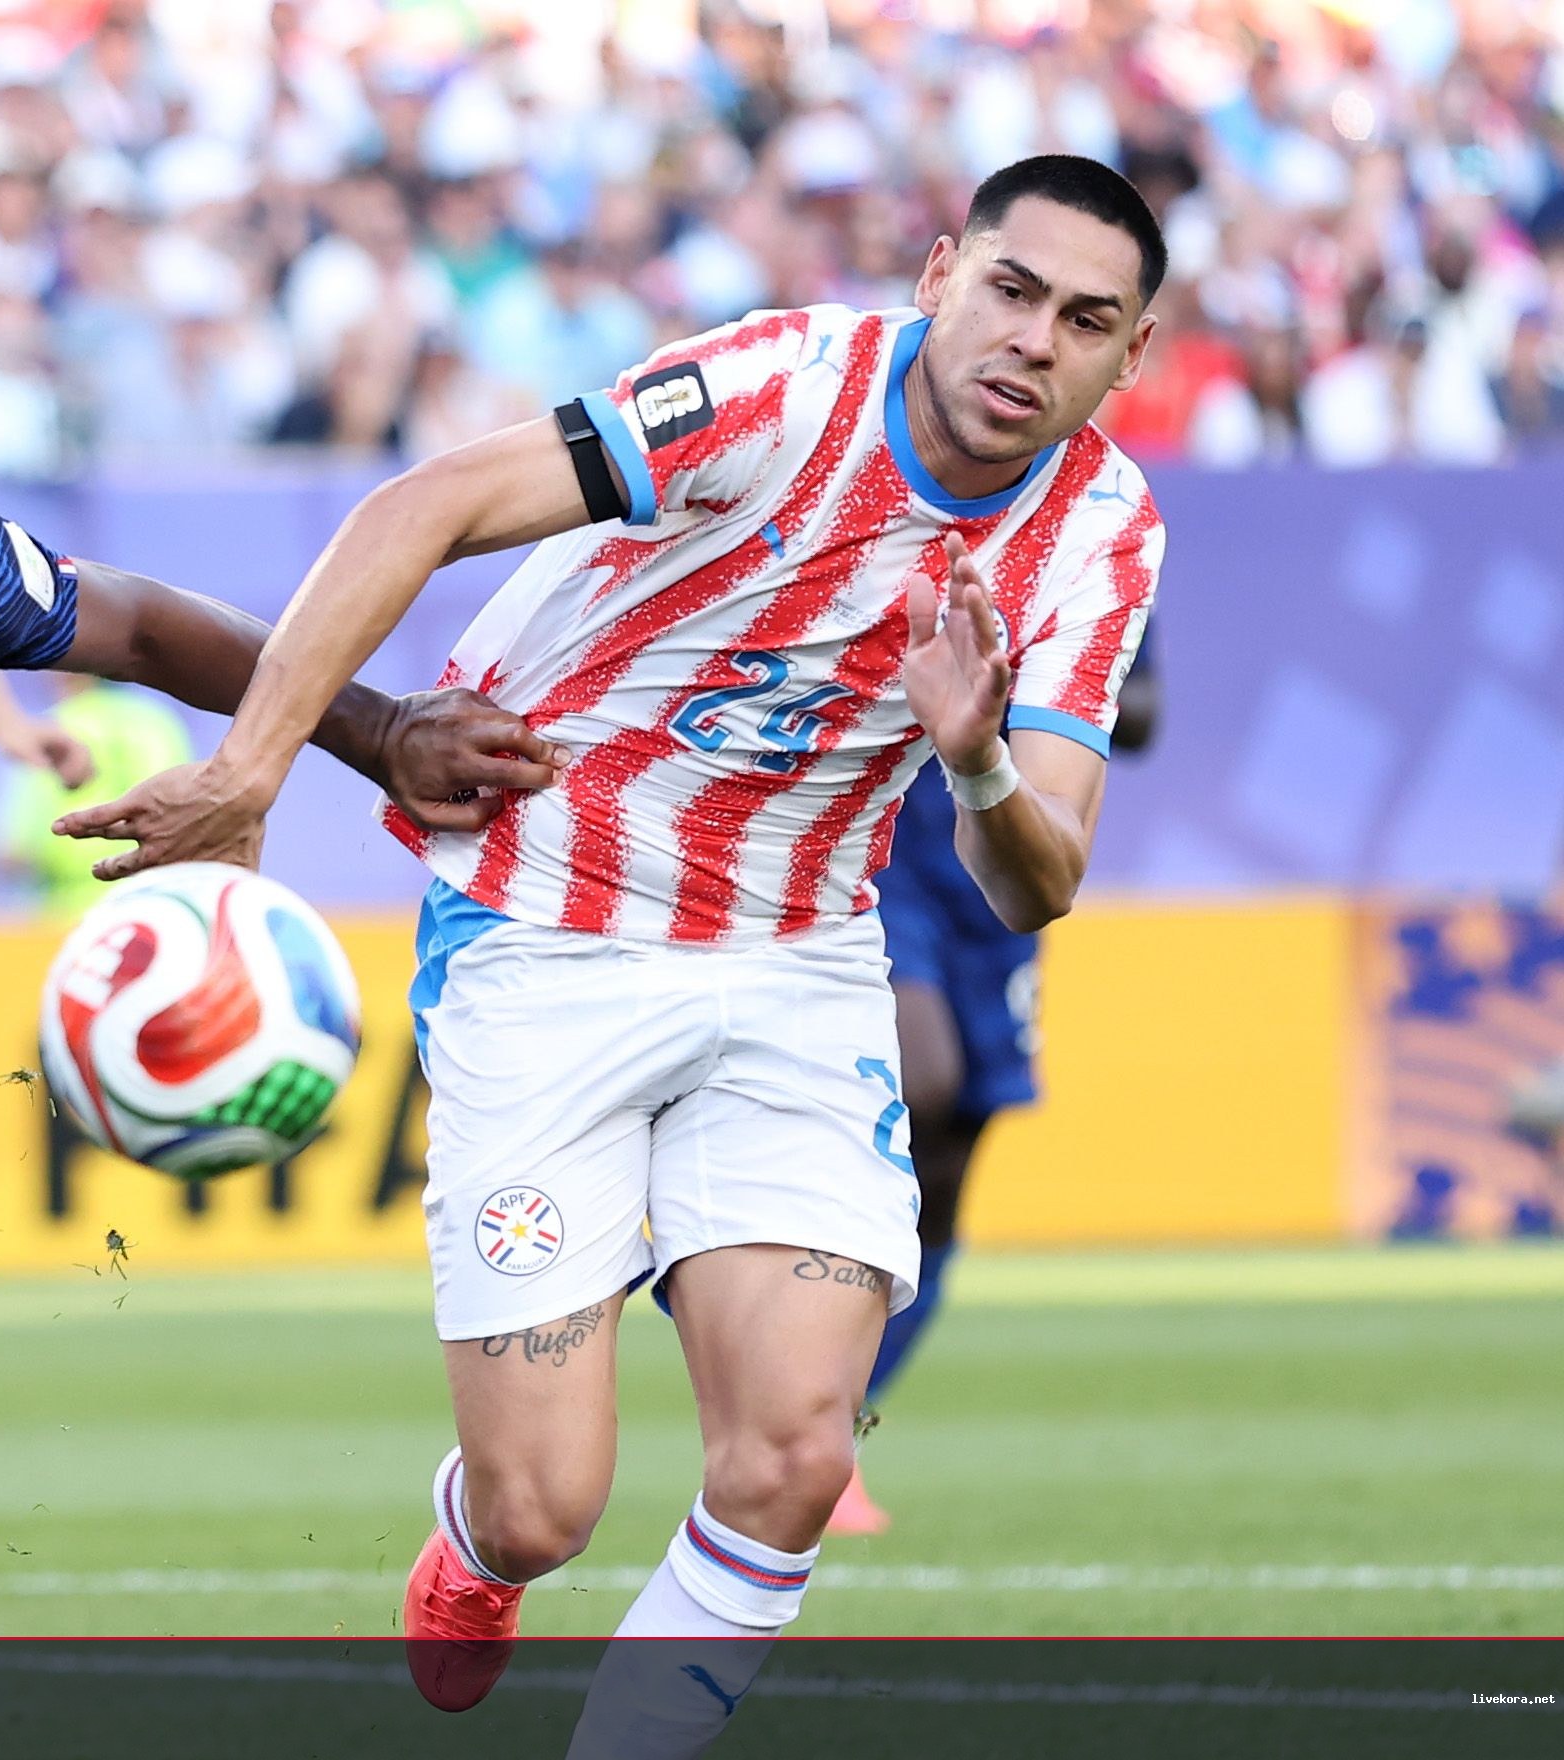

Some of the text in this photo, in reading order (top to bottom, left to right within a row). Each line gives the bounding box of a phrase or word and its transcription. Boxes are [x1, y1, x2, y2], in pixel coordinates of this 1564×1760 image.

[666, 649, 856, 775] 24
[499, 1192, 527, 1210] APF
[506, 1255, 546, 1270] PARAGUAY
